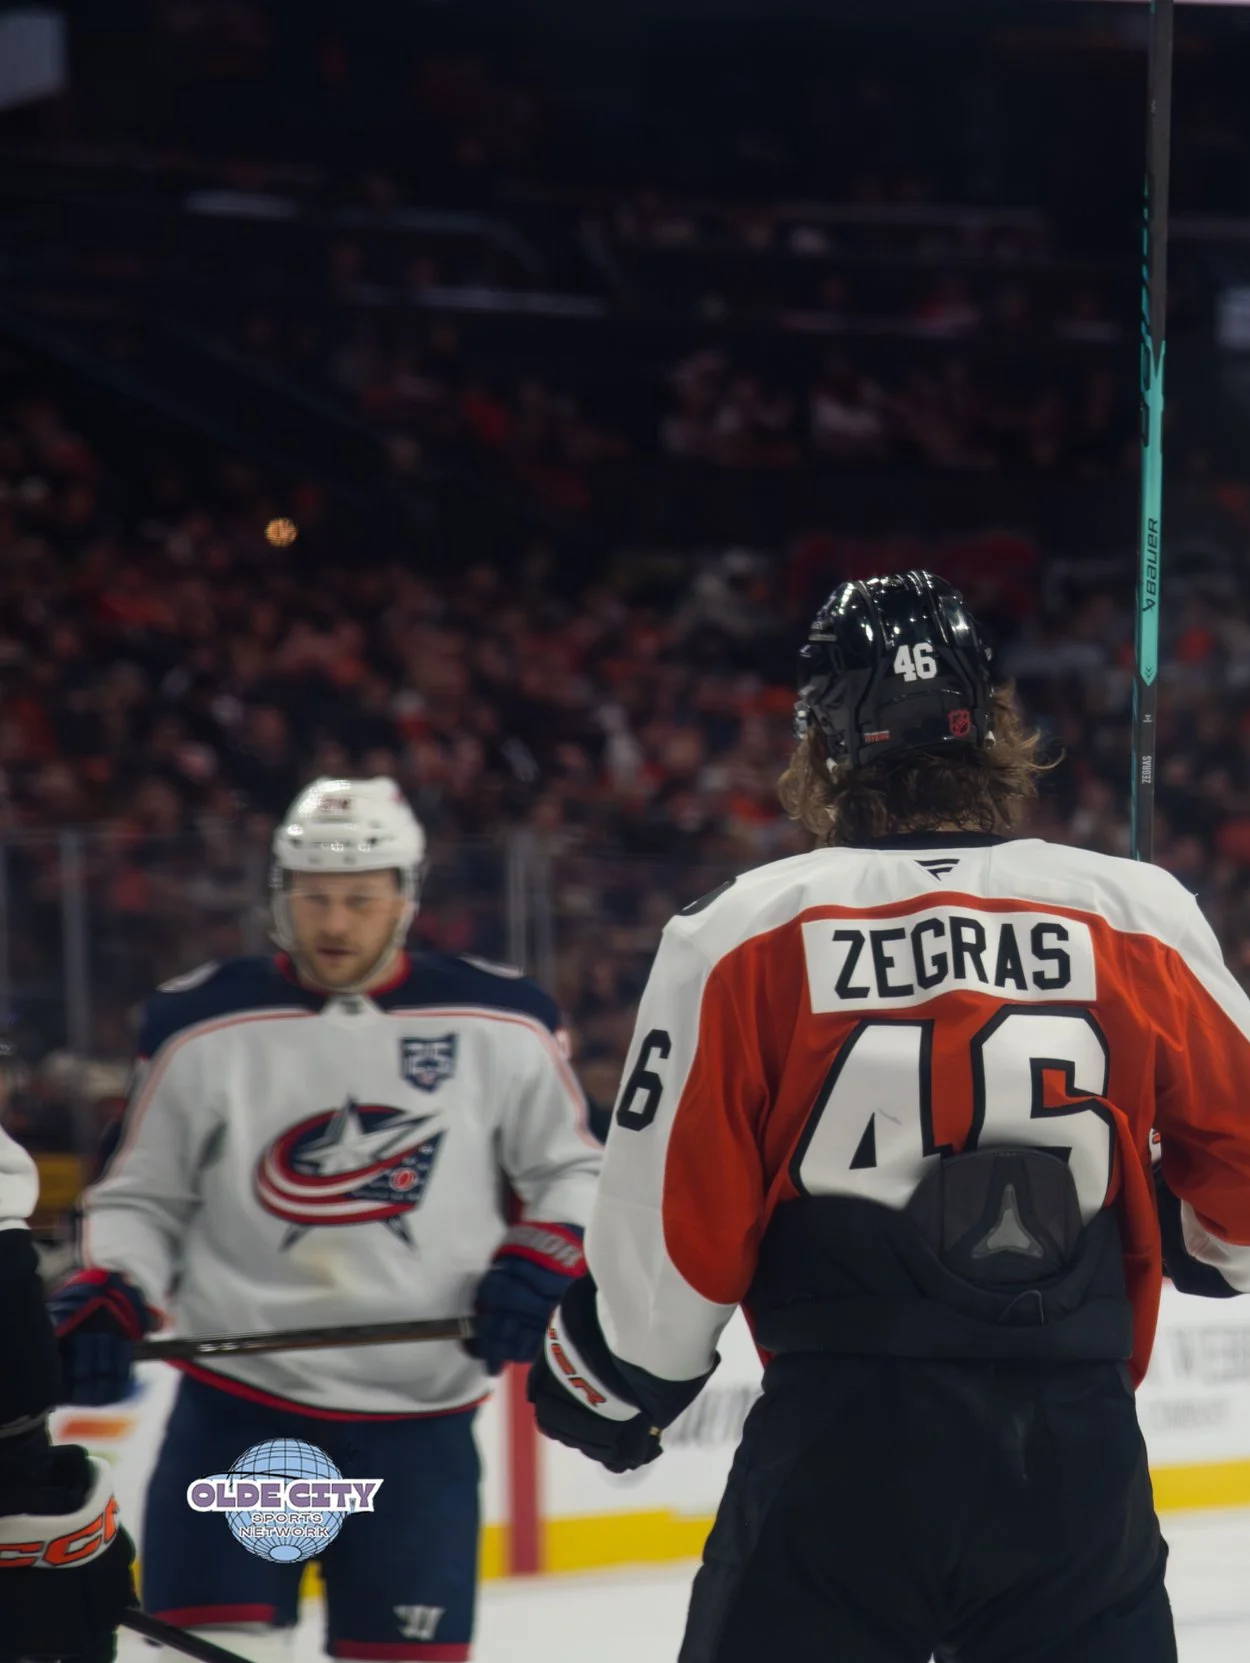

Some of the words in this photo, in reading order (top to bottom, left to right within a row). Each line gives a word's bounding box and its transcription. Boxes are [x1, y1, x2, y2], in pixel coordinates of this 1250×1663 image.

[894, 642, 938, 682] 46
[832, 916, 1071, 999] ZEGRAS
[616, 1029, 672, 1132] 6
[788, 1004, 1116, 1226] 46
